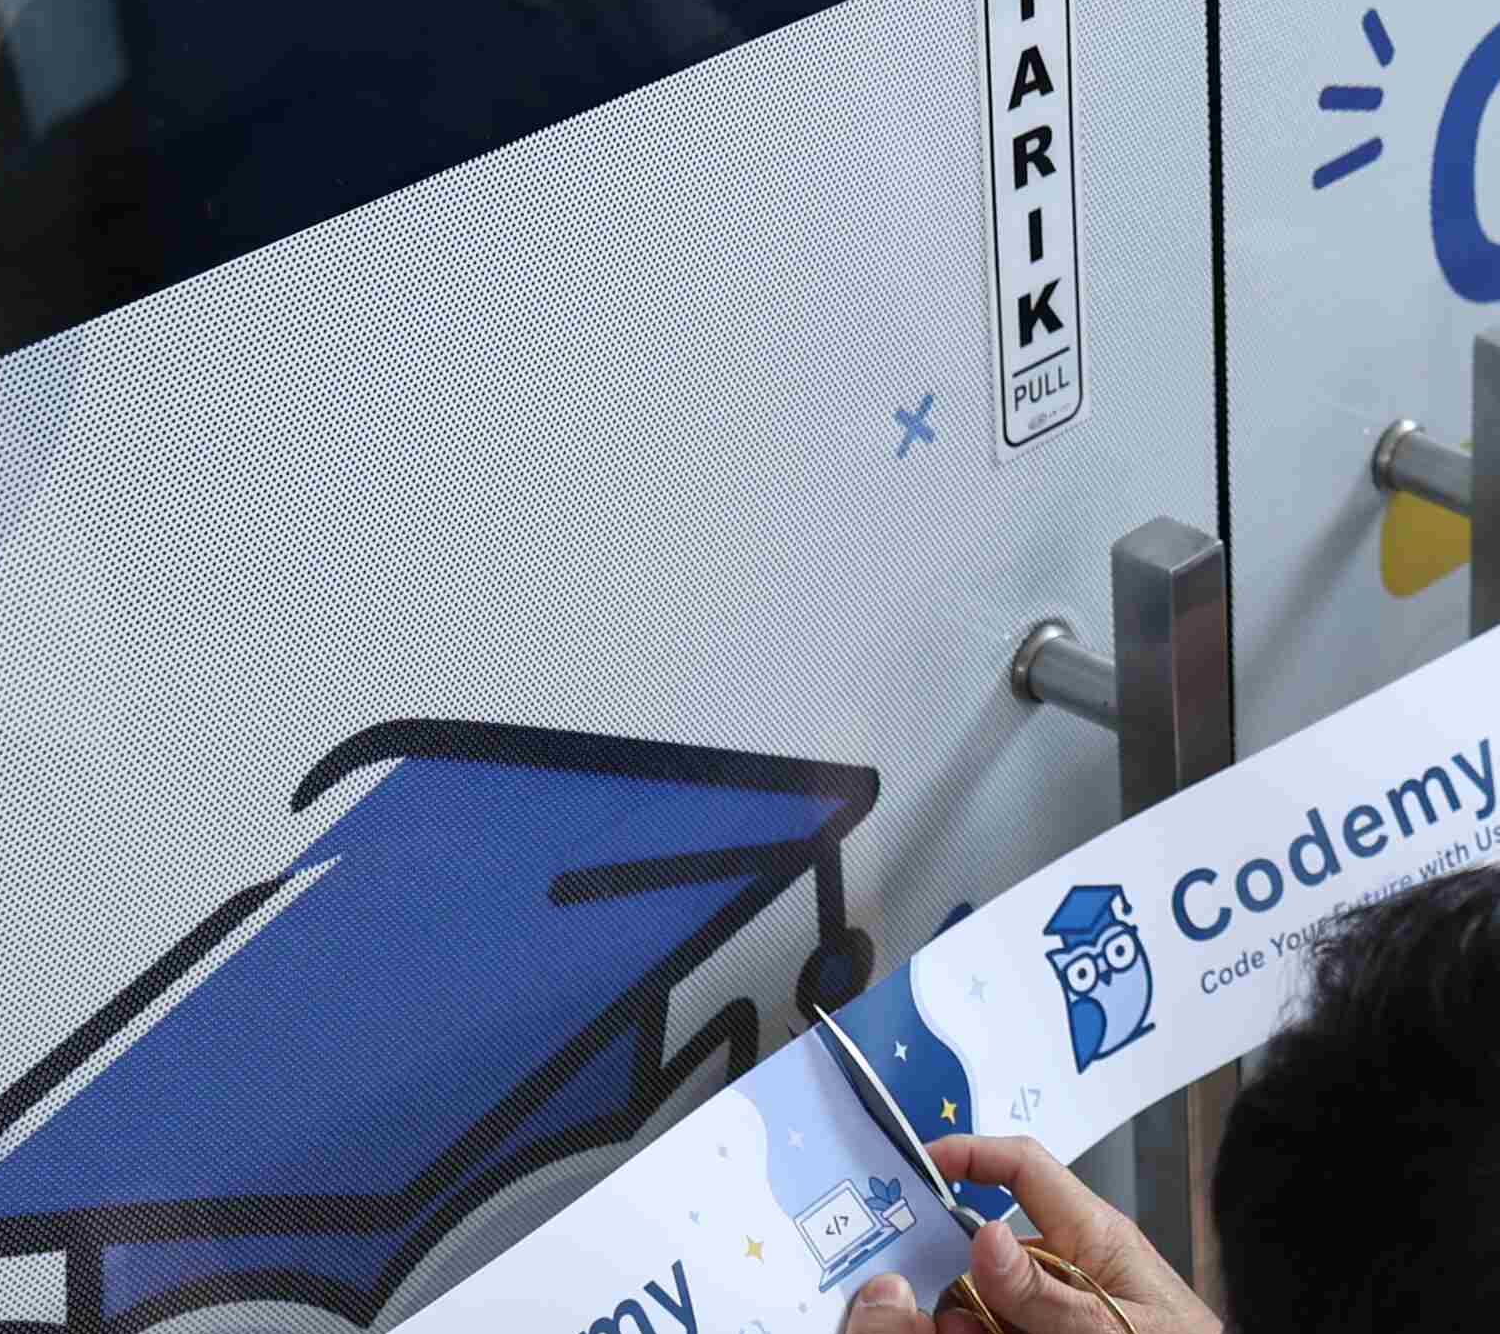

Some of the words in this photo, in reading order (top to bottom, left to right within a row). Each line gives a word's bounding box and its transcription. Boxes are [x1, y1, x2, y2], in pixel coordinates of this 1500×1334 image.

[1013, 365, 1071, 412] PULL
[1171, 738, 1497, 942] Codemy
[1201, 946, 1265, 995] Code
[1419, 839, 1470, 881] with
